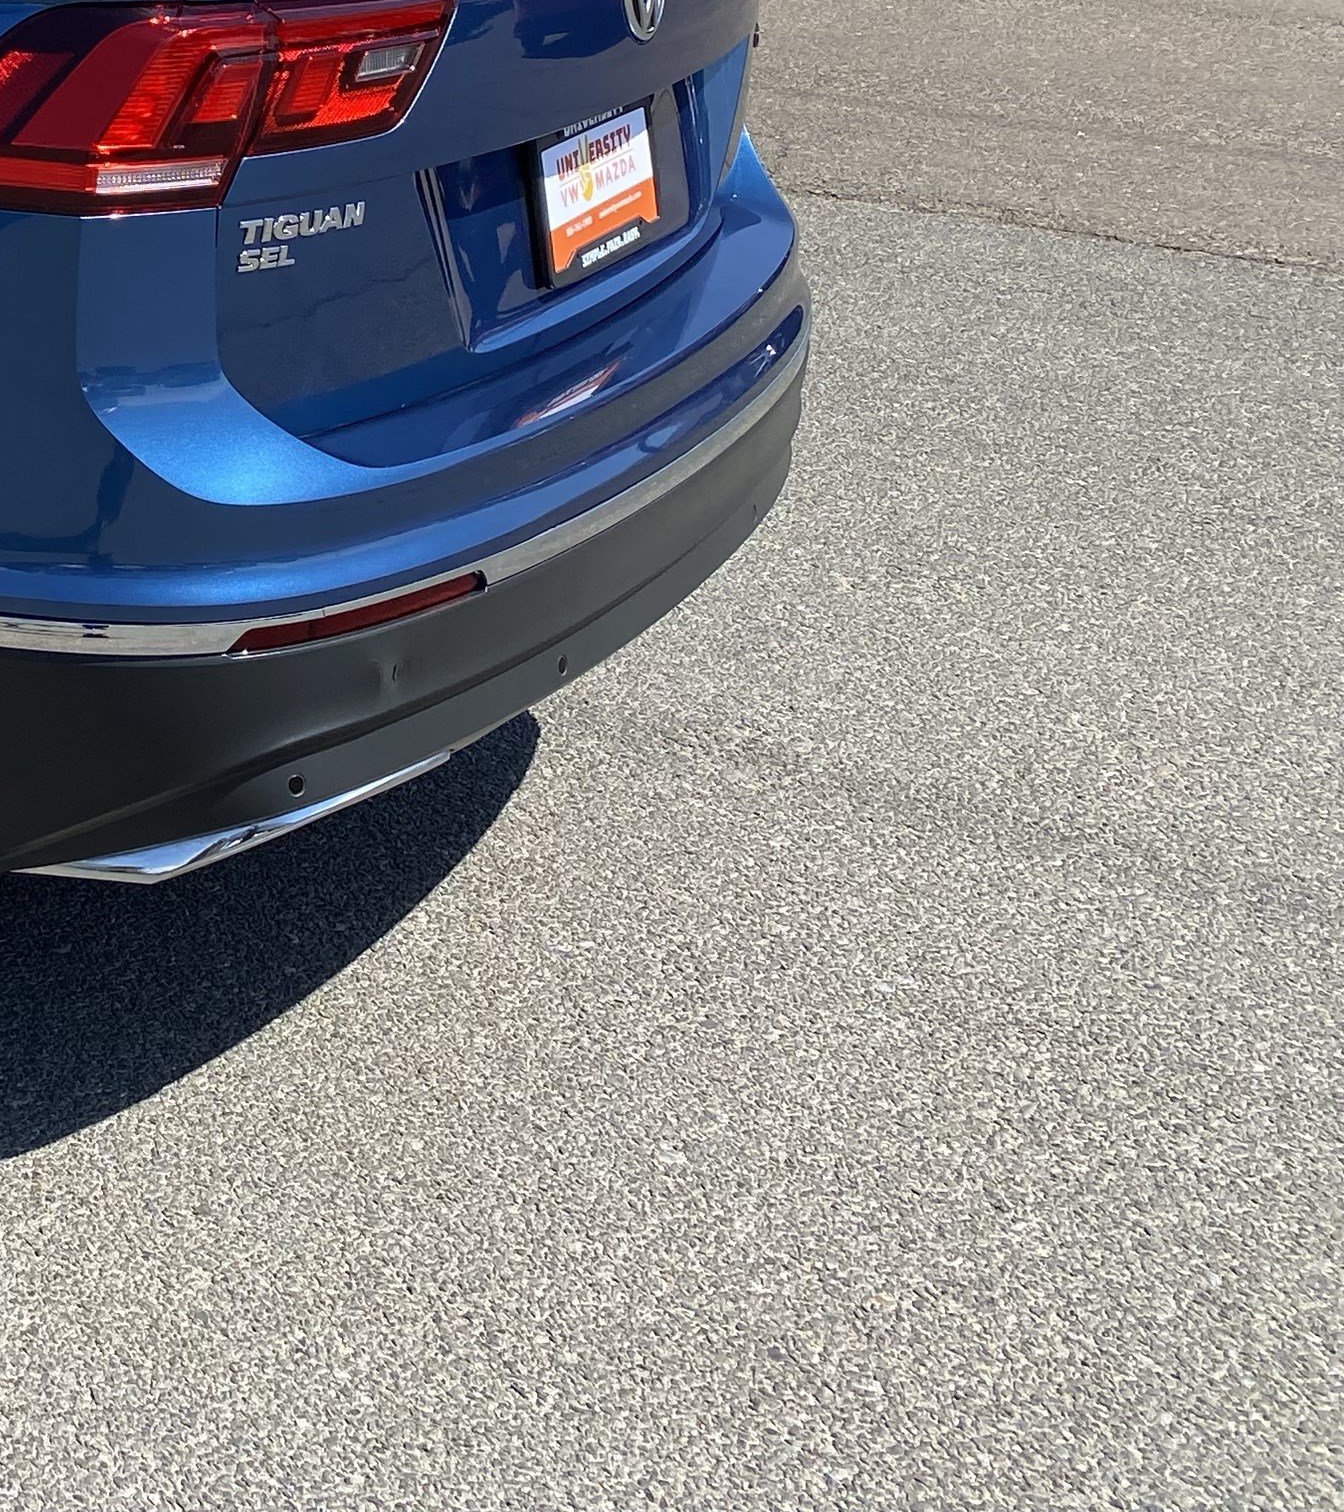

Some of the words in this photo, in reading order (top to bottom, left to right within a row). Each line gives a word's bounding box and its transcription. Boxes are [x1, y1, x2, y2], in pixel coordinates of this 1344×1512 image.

[556, 123, 632, 181] UNIVERSITY
[560, 178, 580, 208] VW
[594, 154, 637, 192] MAZDA
[239, 200, 366, 245] TIGUAN
[237, 244, 296, 273] SEL
